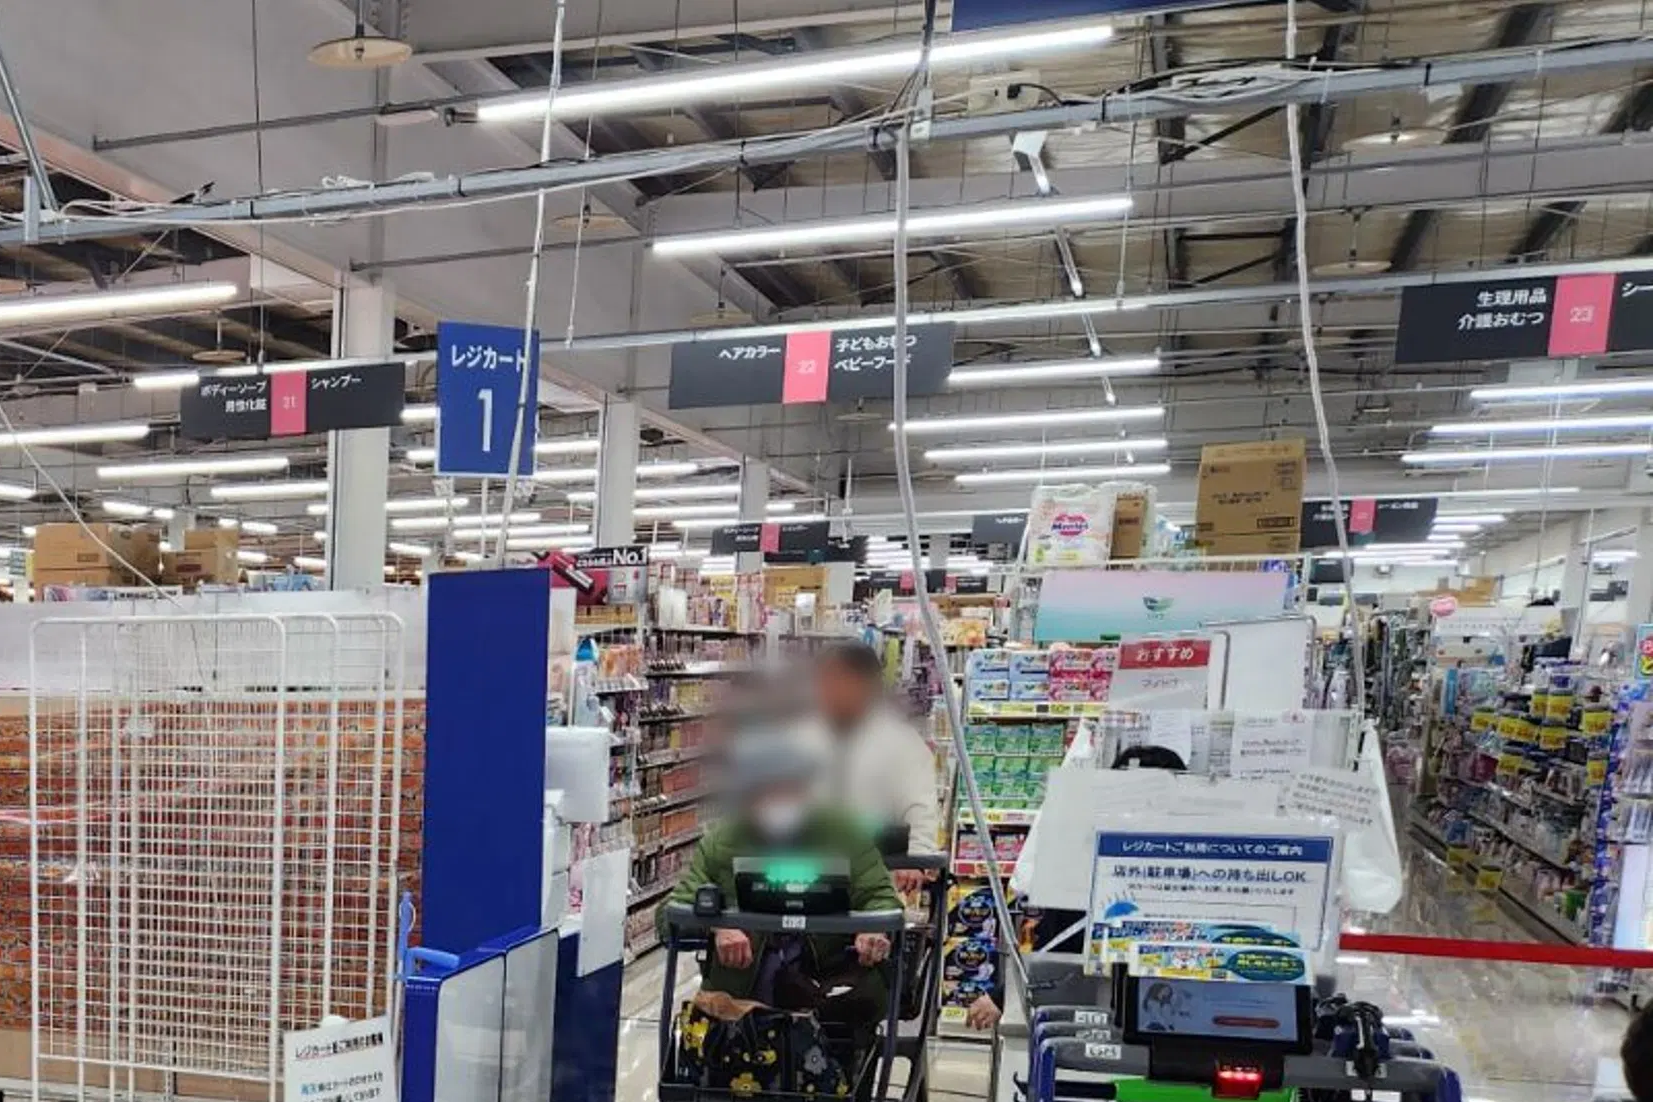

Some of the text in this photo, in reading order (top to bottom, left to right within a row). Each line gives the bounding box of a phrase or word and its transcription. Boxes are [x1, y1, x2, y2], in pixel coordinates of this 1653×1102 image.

[1477, 287, 1547, 308] 生理用品
[1458, 312, 1544, 331] 介護おむつ
[1569, 306, 1594, 323] 23
[452, 344, 526, 373] レジカート
[718, 346, 781, 361] ヘアカラー
[200, 381, 267, 397] ボディーソープ
[311, 375, 362, 389] シャンプー
[478, 388, 493, 452] 1
